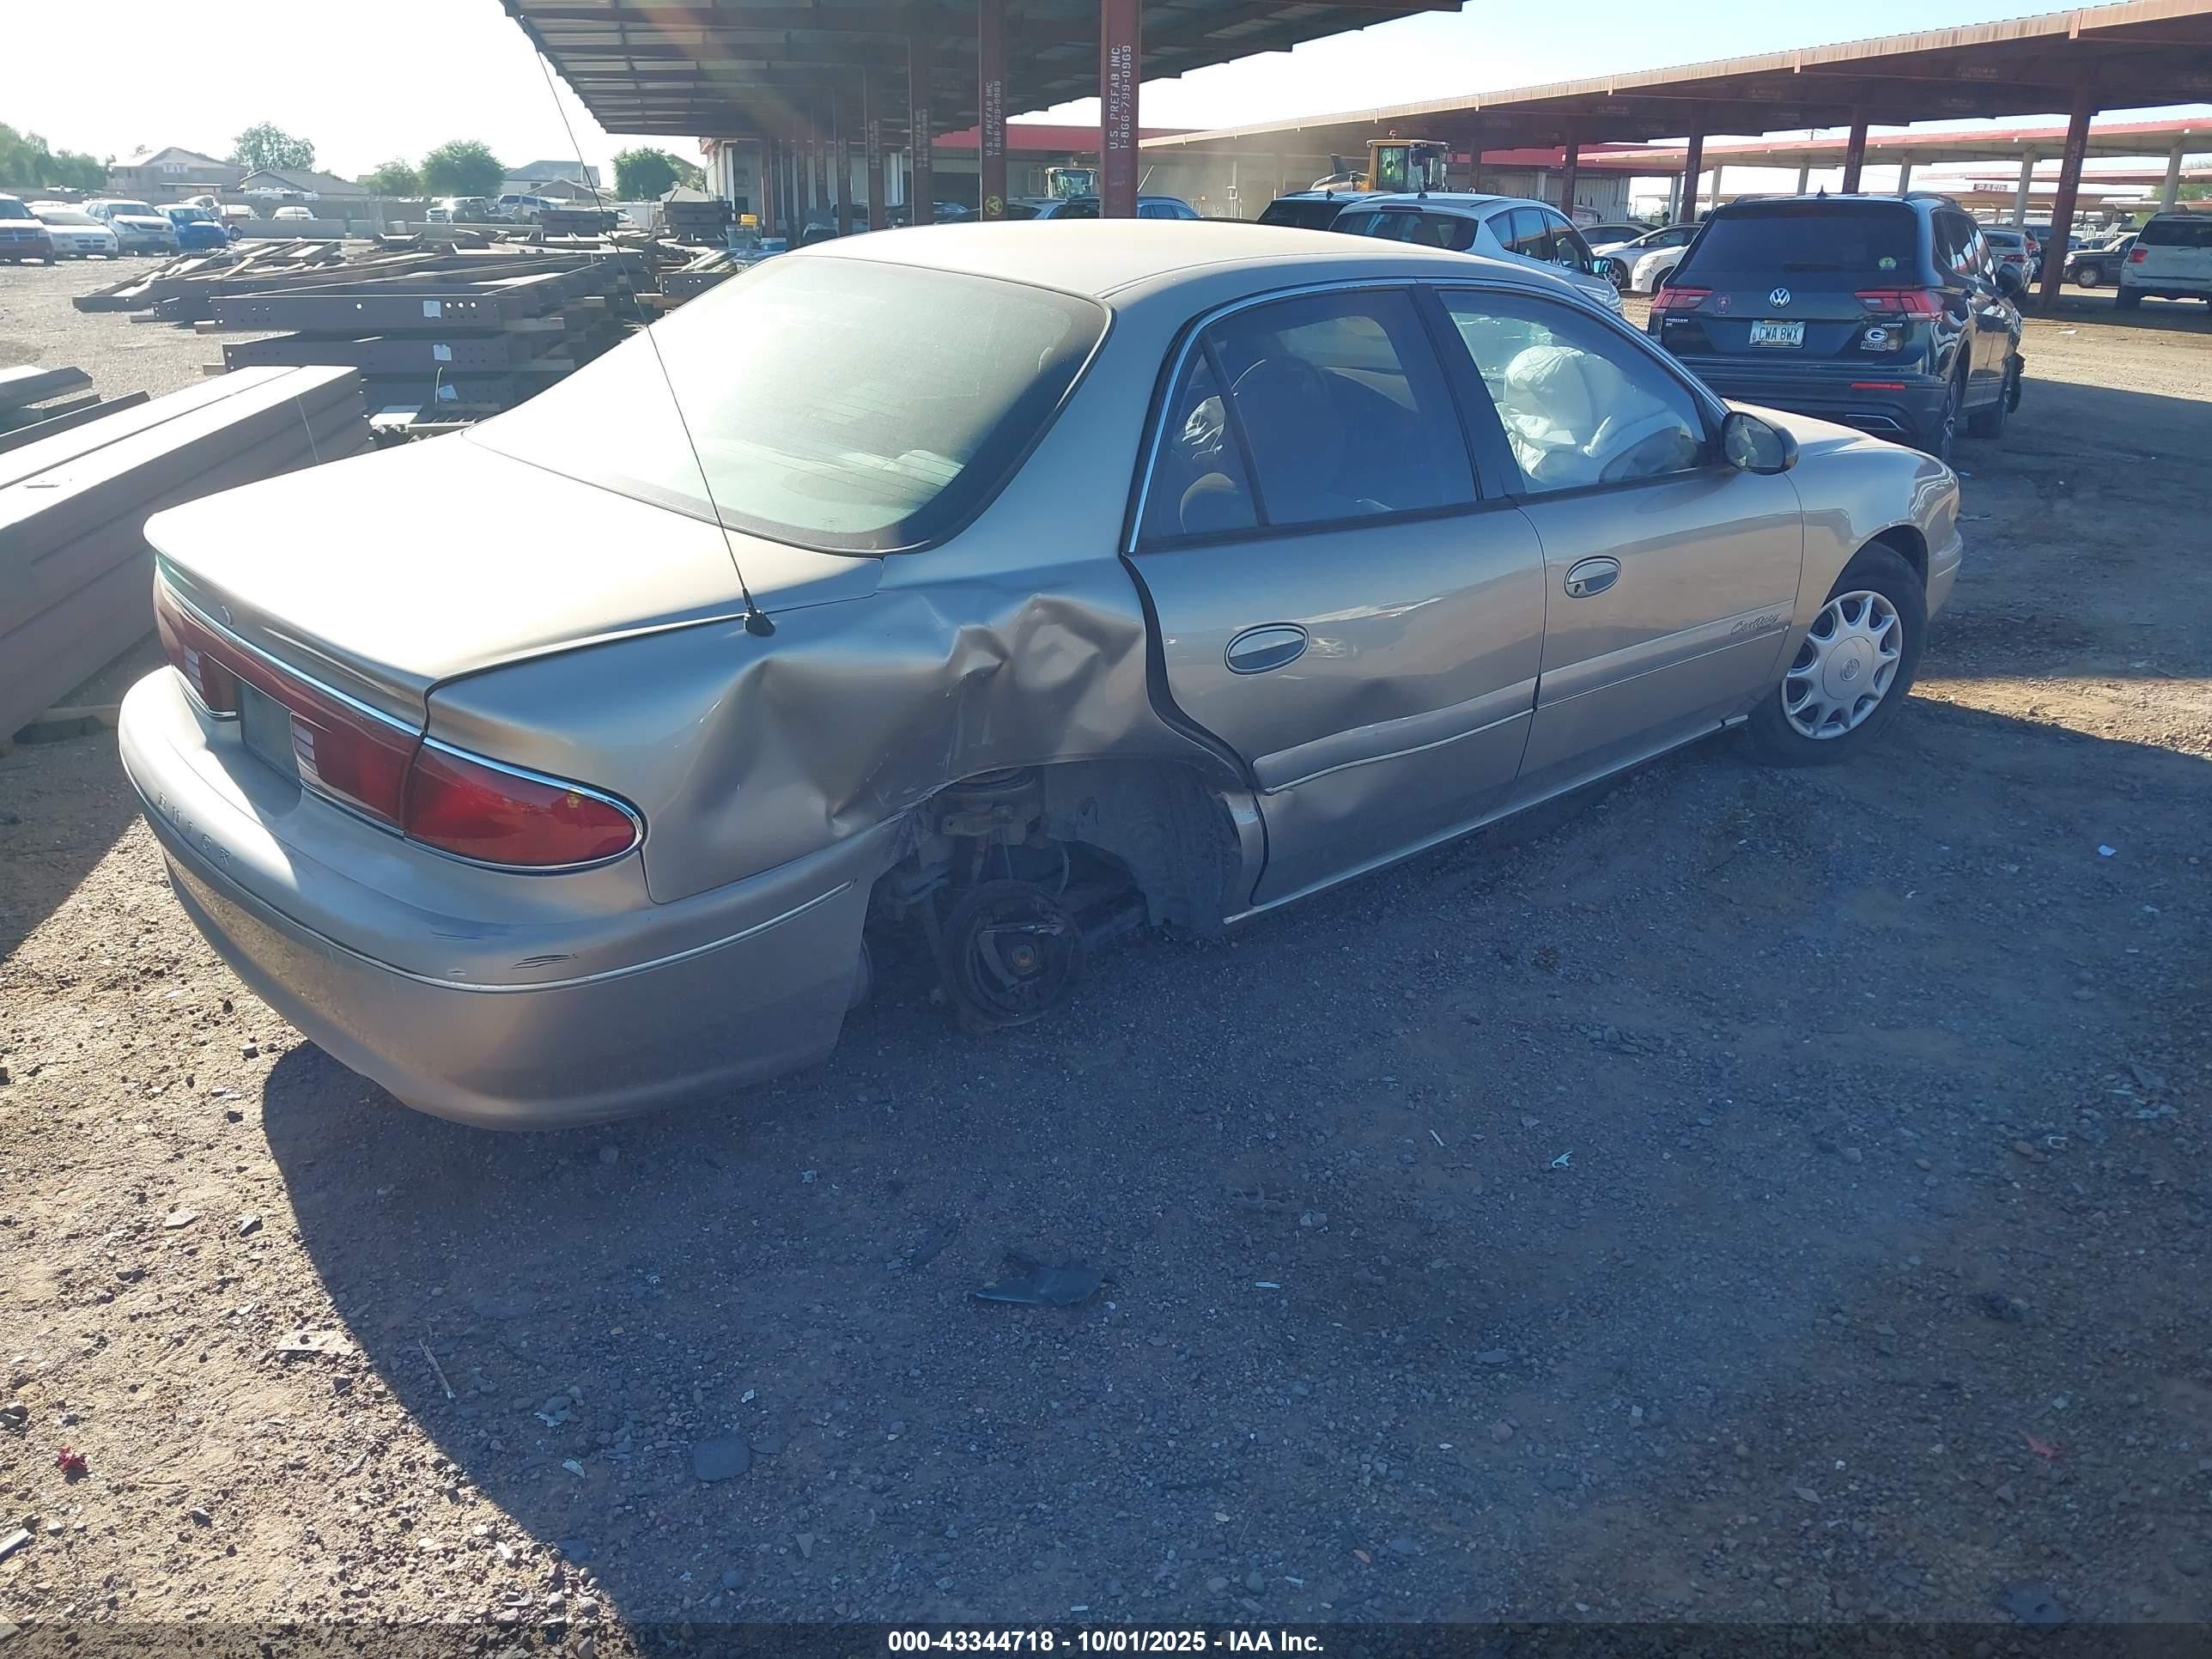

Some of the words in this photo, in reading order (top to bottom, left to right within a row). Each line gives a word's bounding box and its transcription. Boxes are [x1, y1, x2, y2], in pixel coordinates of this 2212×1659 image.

[1110, 44, 1121, 66] INC.
[1109, 73, 1120, 120] PREFAB
[1120, 45, 1132, 149] 1-866-799-0969
[1109, 127, 1120, 149] U.S.
[1759, 326, 1778, 340] CWA
[1780, 327, 1800, 341] 8WX
